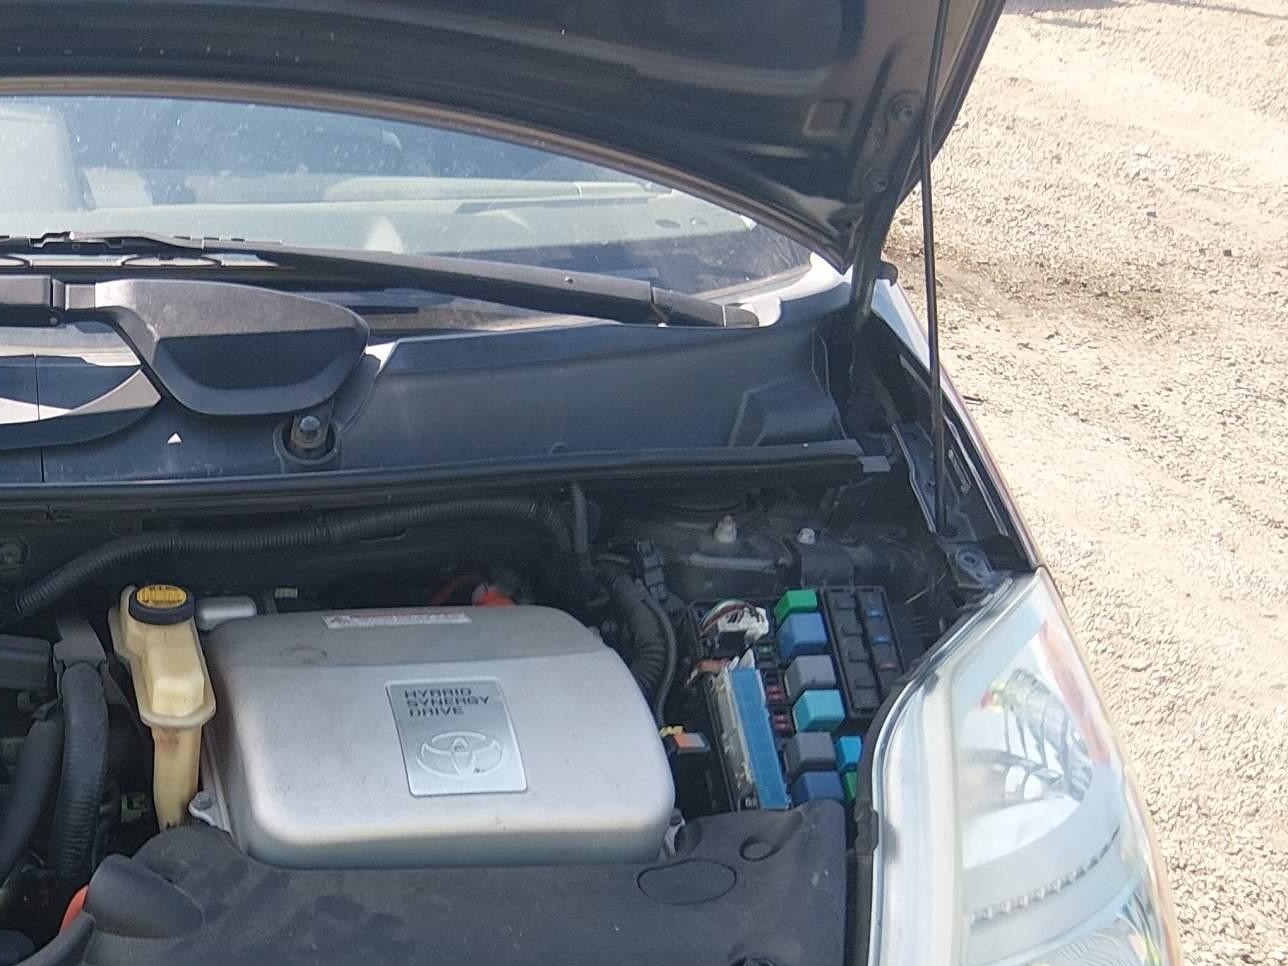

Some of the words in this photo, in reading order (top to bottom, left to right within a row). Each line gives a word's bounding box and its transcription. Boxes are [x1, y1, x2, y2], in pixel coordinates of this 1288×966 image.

[404, 687, 472, 699] HYBRID
[407, 695, 489, 707] SYNERGY
[409, 706, 464, 716] DRIVE
